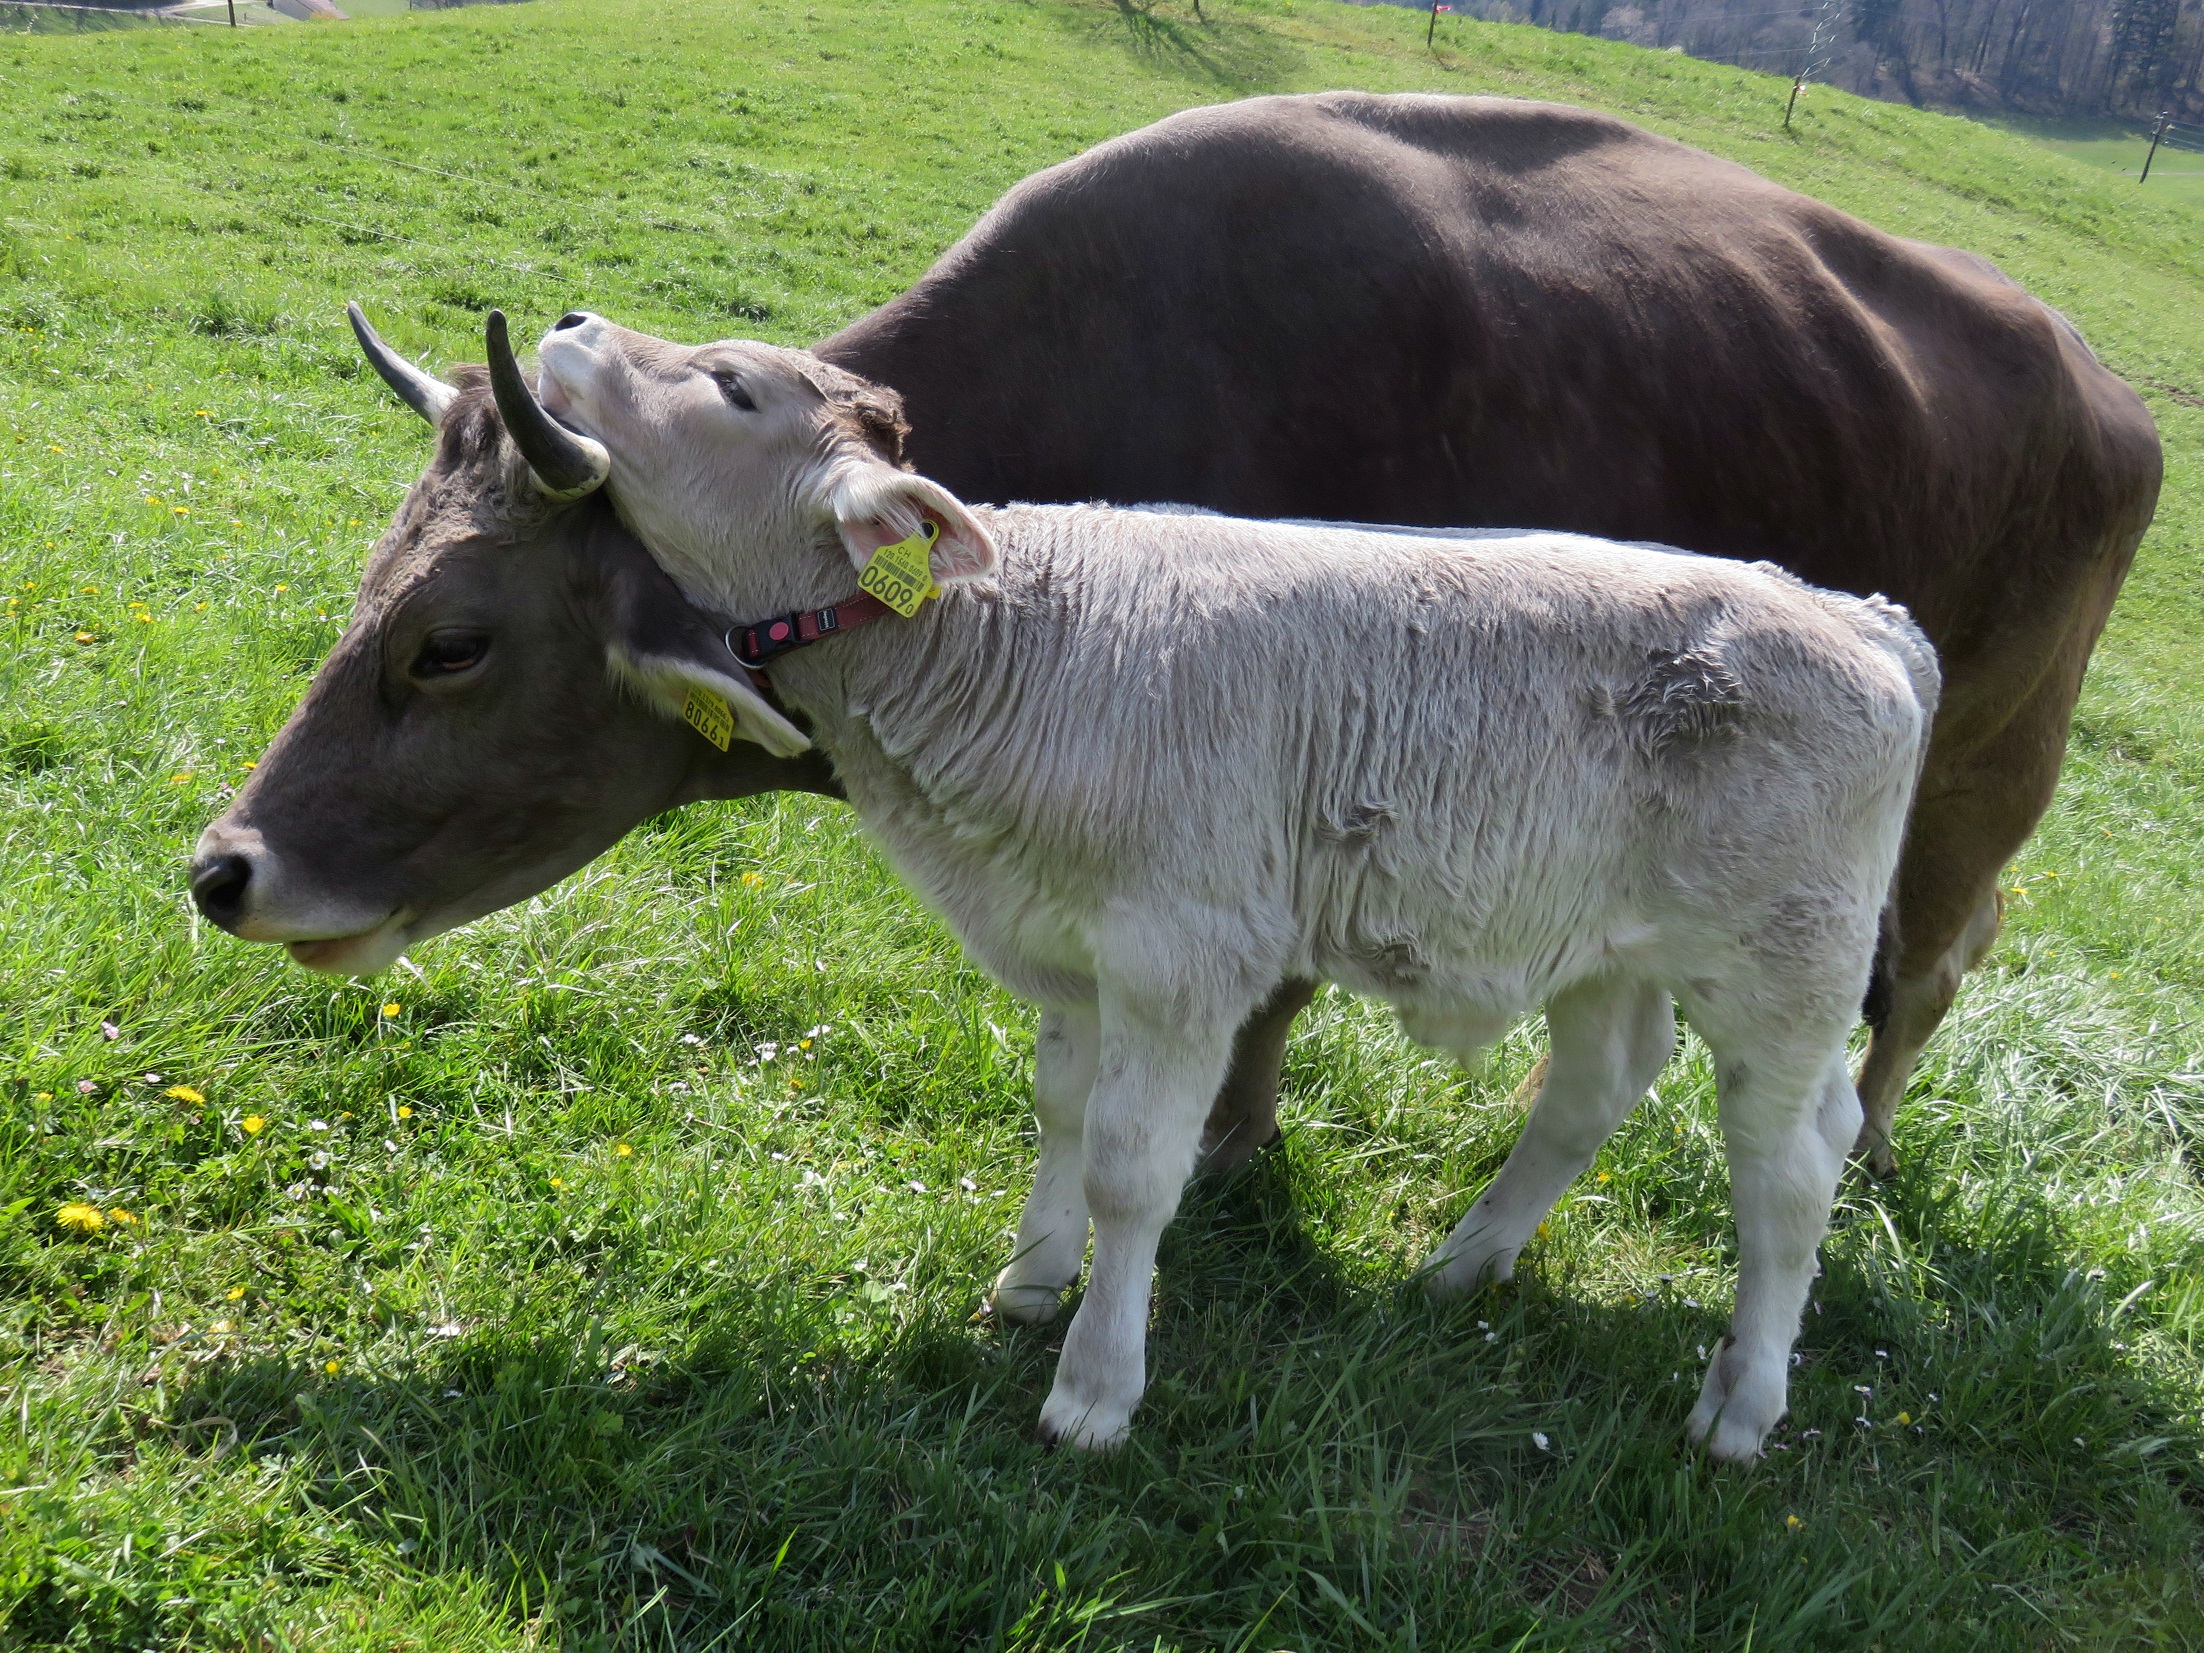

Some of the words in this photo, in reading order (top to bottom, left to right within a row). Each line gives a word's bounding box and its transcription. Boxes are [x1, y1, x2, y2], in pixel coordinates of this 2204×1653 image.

[898, 547, 912, 558] CH
[860, 565, 913, 609] 0609
[685, 700, 718, 741] 8066
